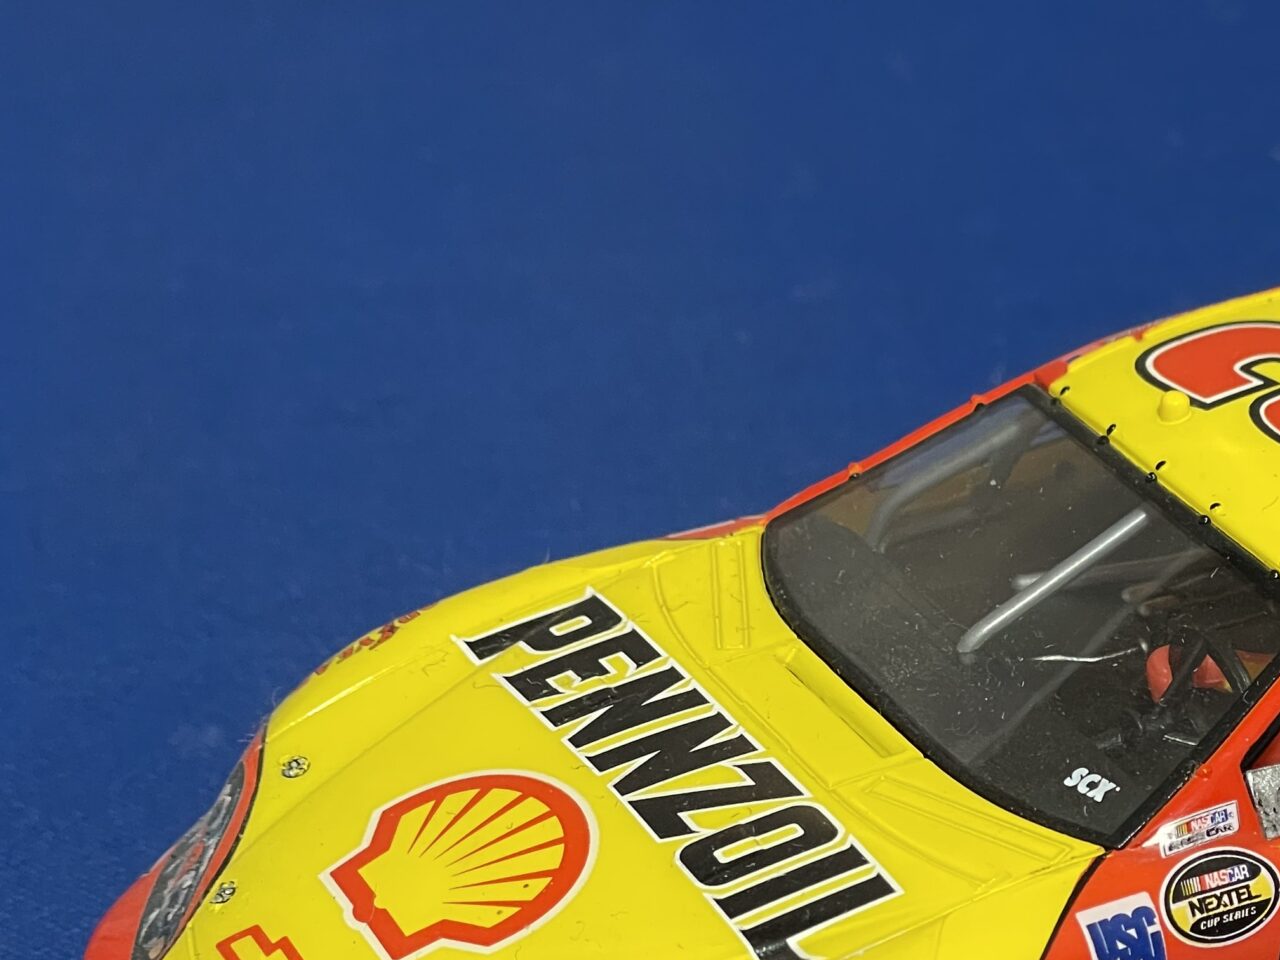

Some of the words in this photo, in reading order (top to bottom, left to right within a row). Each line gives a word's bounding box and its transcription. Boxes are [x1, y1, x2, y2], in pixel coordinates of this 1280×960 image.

[1063, 767, 1117, 802] SCX
[1190, 808, 1229, 832] NASCAR
[1202, 864, 1250, 891] NASCAR
[1188, 884, 1262, 917] NEXTEL
[1200, 915, 1221, 930] CUP
[1222, 906, 1257, 924] SERIES
